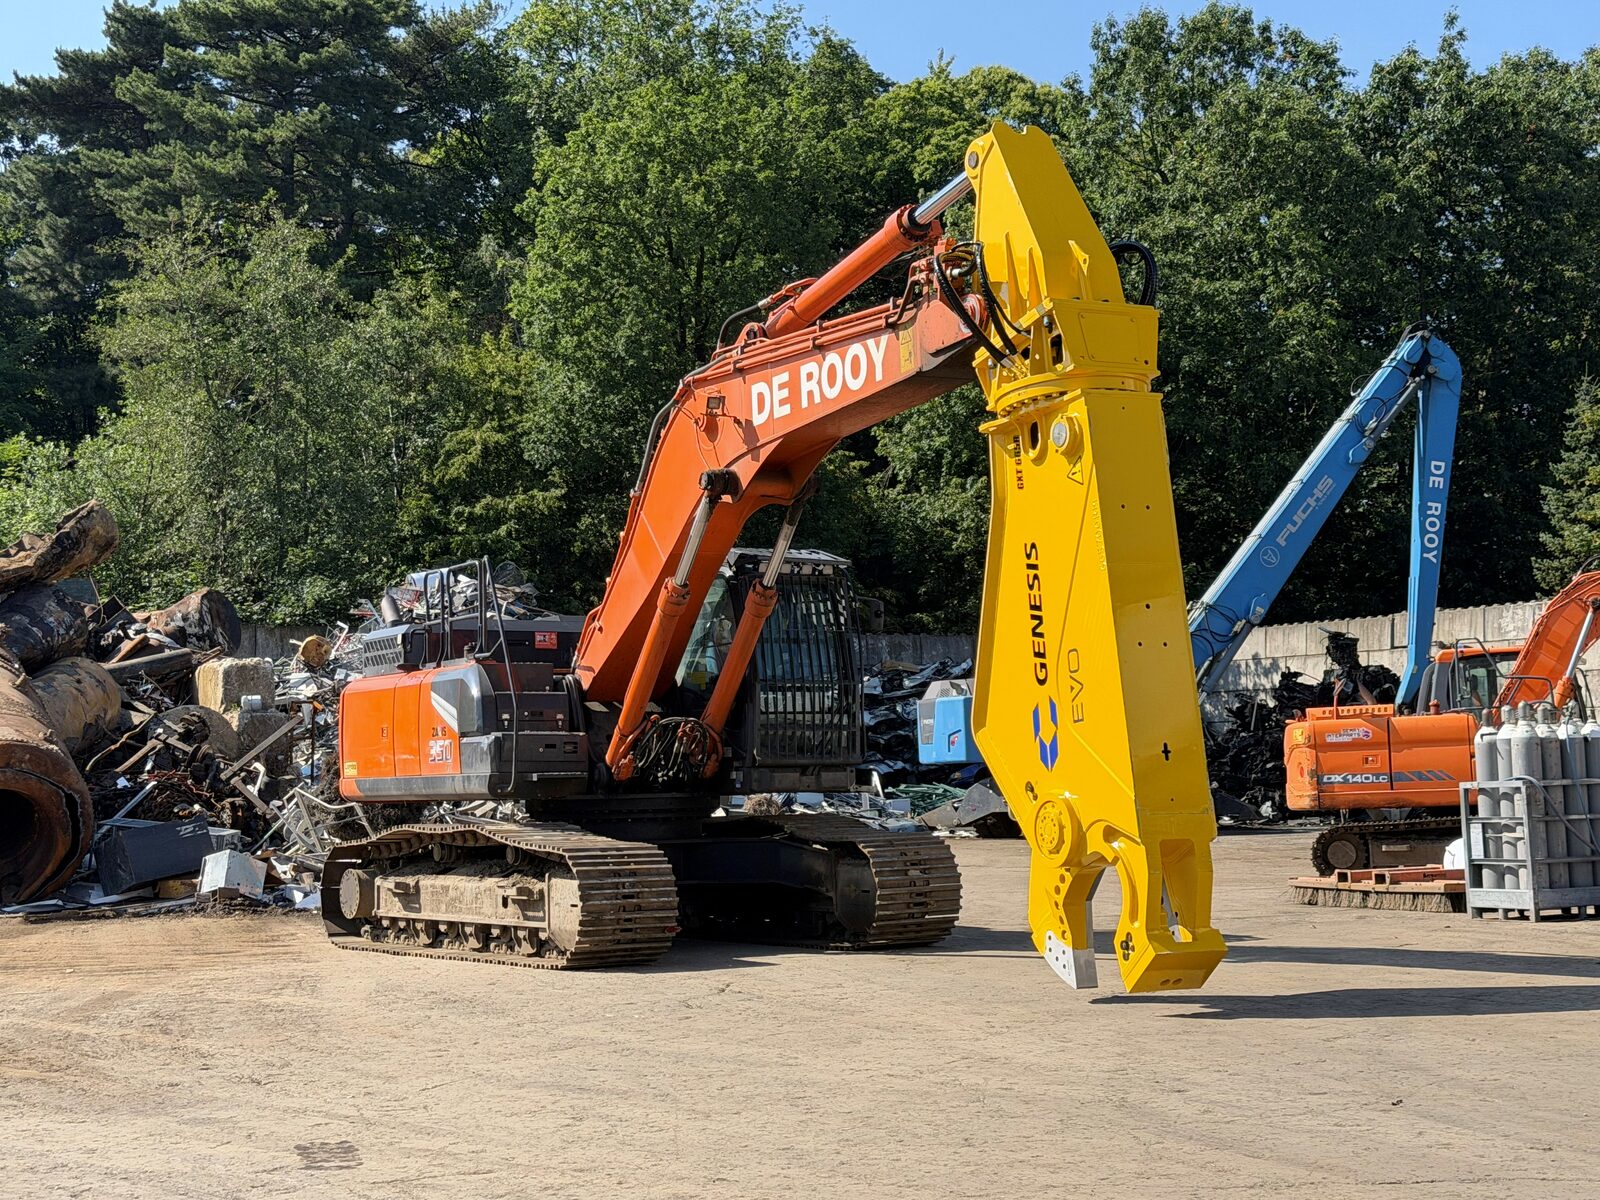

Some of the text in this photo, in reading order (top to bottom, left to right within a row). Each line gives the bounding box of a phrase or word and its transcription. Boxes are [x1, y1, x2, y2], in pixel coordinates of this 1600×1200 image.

[751, 334, 890, 426] DE ROOY
[1015, 468, 1024, 490] GXT
[1276, 474, 1335, 547] FUCHS
[1423, 460, 1446, 564] DE ROOY
[1024, 541, 1049, 687] GENESIS
[1067, 647, 1085, 724] EVO
[429, 740, 454, 764] 350
[432, 726, 447, 738] ZAIS
